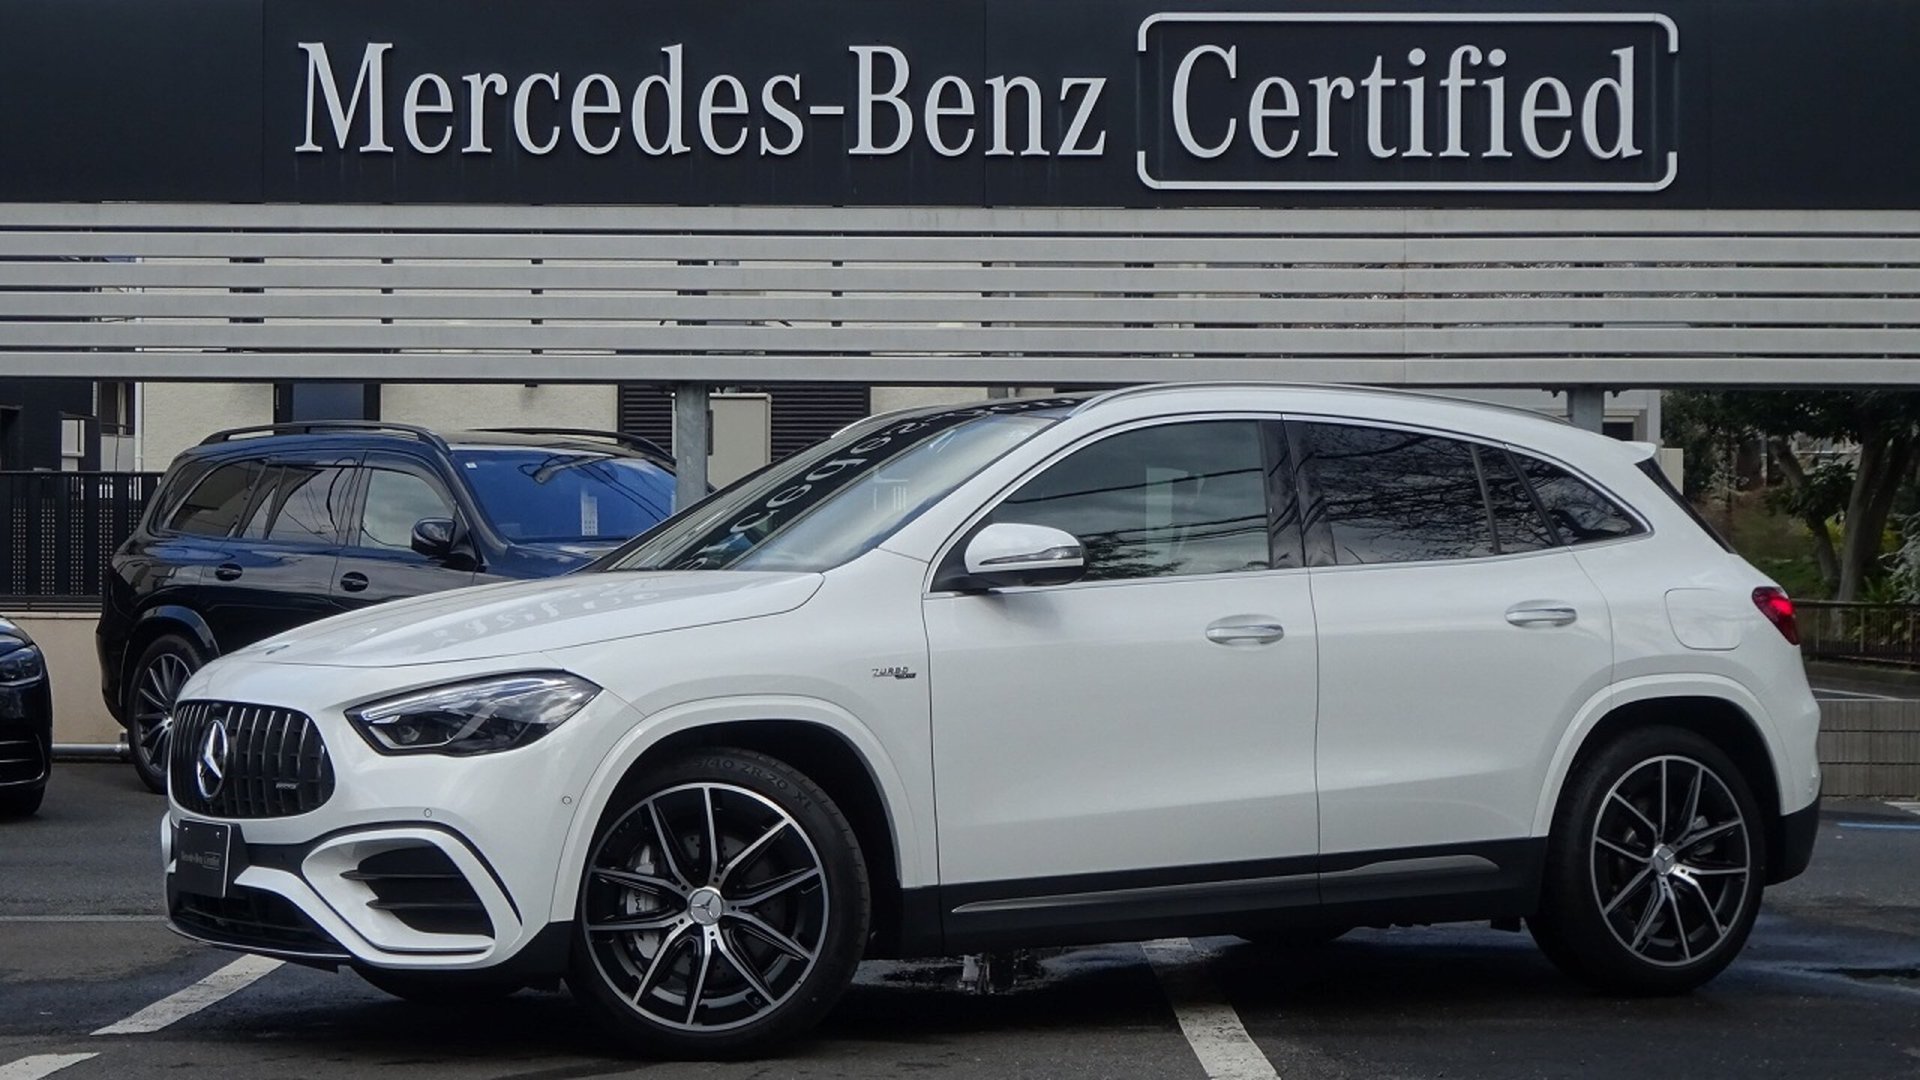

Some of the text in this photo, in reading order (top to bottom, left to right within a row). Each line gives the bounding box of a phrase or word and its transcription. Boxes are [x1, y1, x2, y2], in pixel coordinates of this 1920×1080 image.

[295, 42, 1643, 159] Mercedes-Benz Certified
[767, 773, 789, 790] 20
